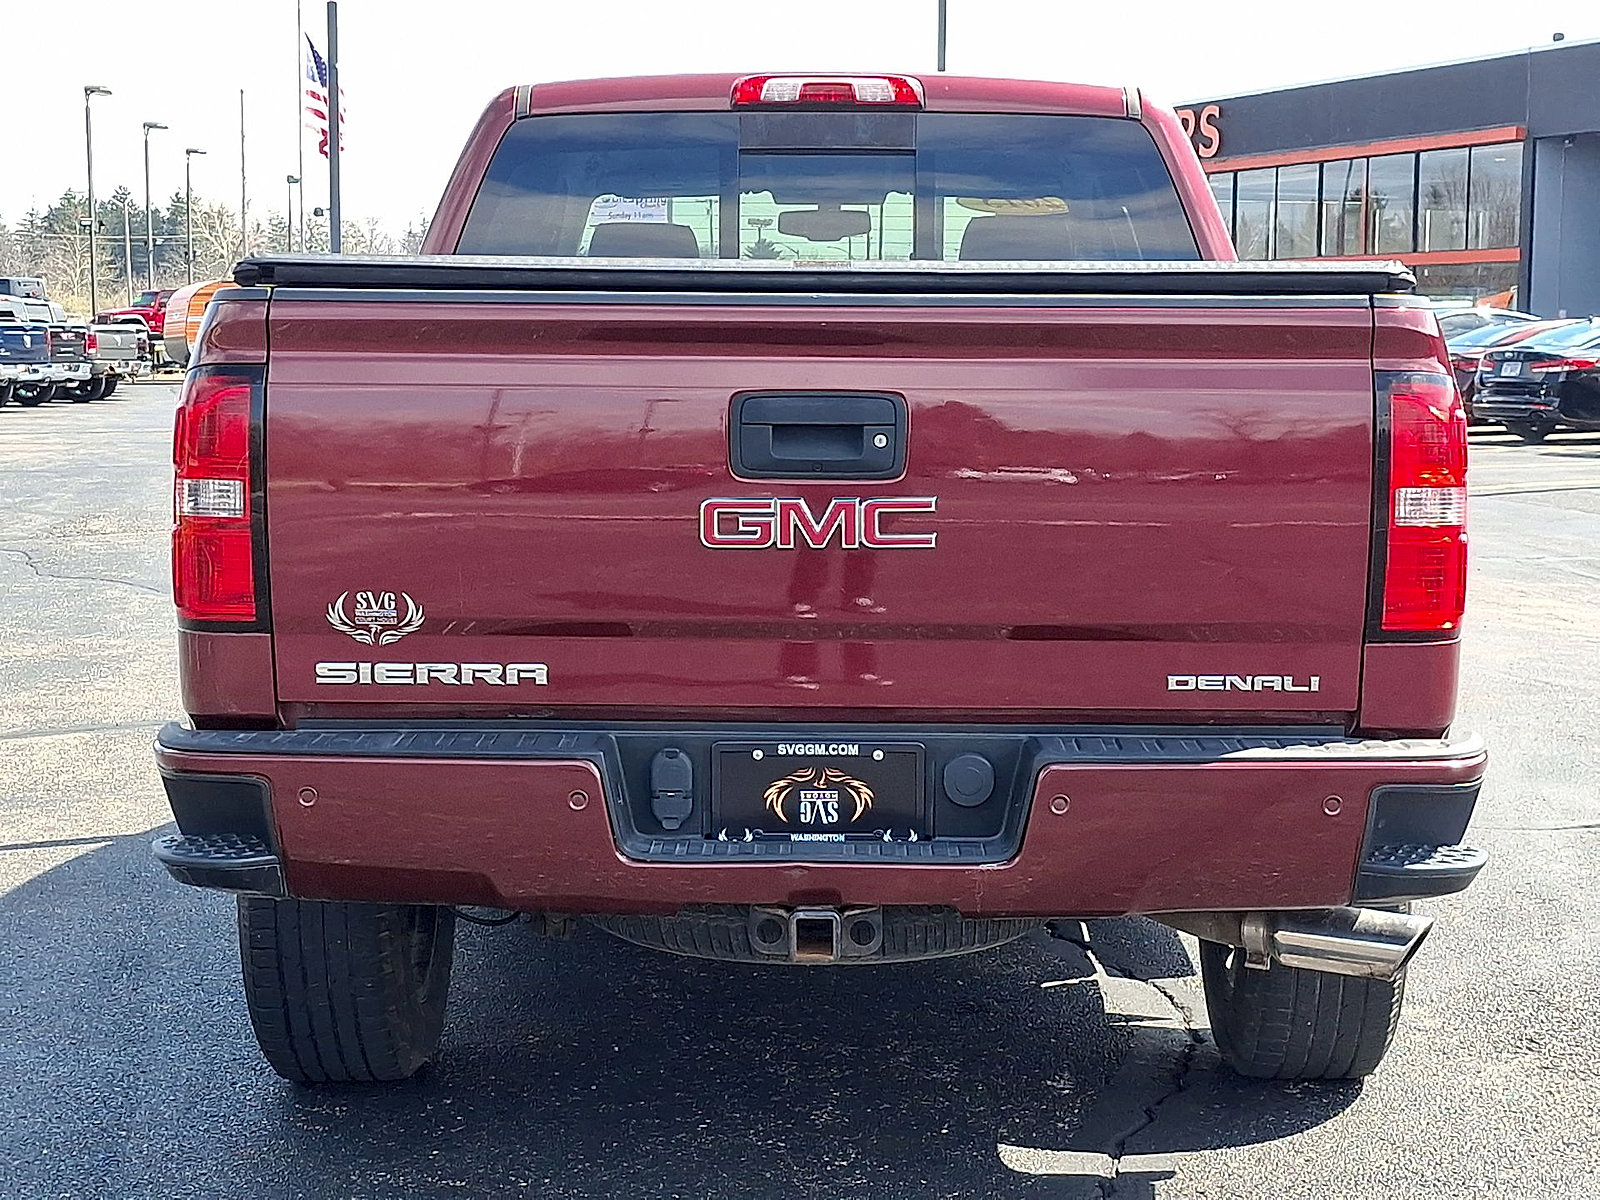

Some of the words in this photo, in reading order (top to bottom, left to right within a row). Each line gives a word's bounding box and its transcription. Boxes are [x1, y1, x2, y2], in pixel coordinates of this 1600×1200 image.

[700, 496, 938, 549] GMC
[355, 590, 397, 611] SVG
[315, 661, 549, 685] SIERRA
[1166, 674, 1321, 692] DENALI
[777, 743, 860, 756] SVGGM.COM
[800, 800, 840, 825] SVG
[790, 833, 846, 843] WASHINGTON
